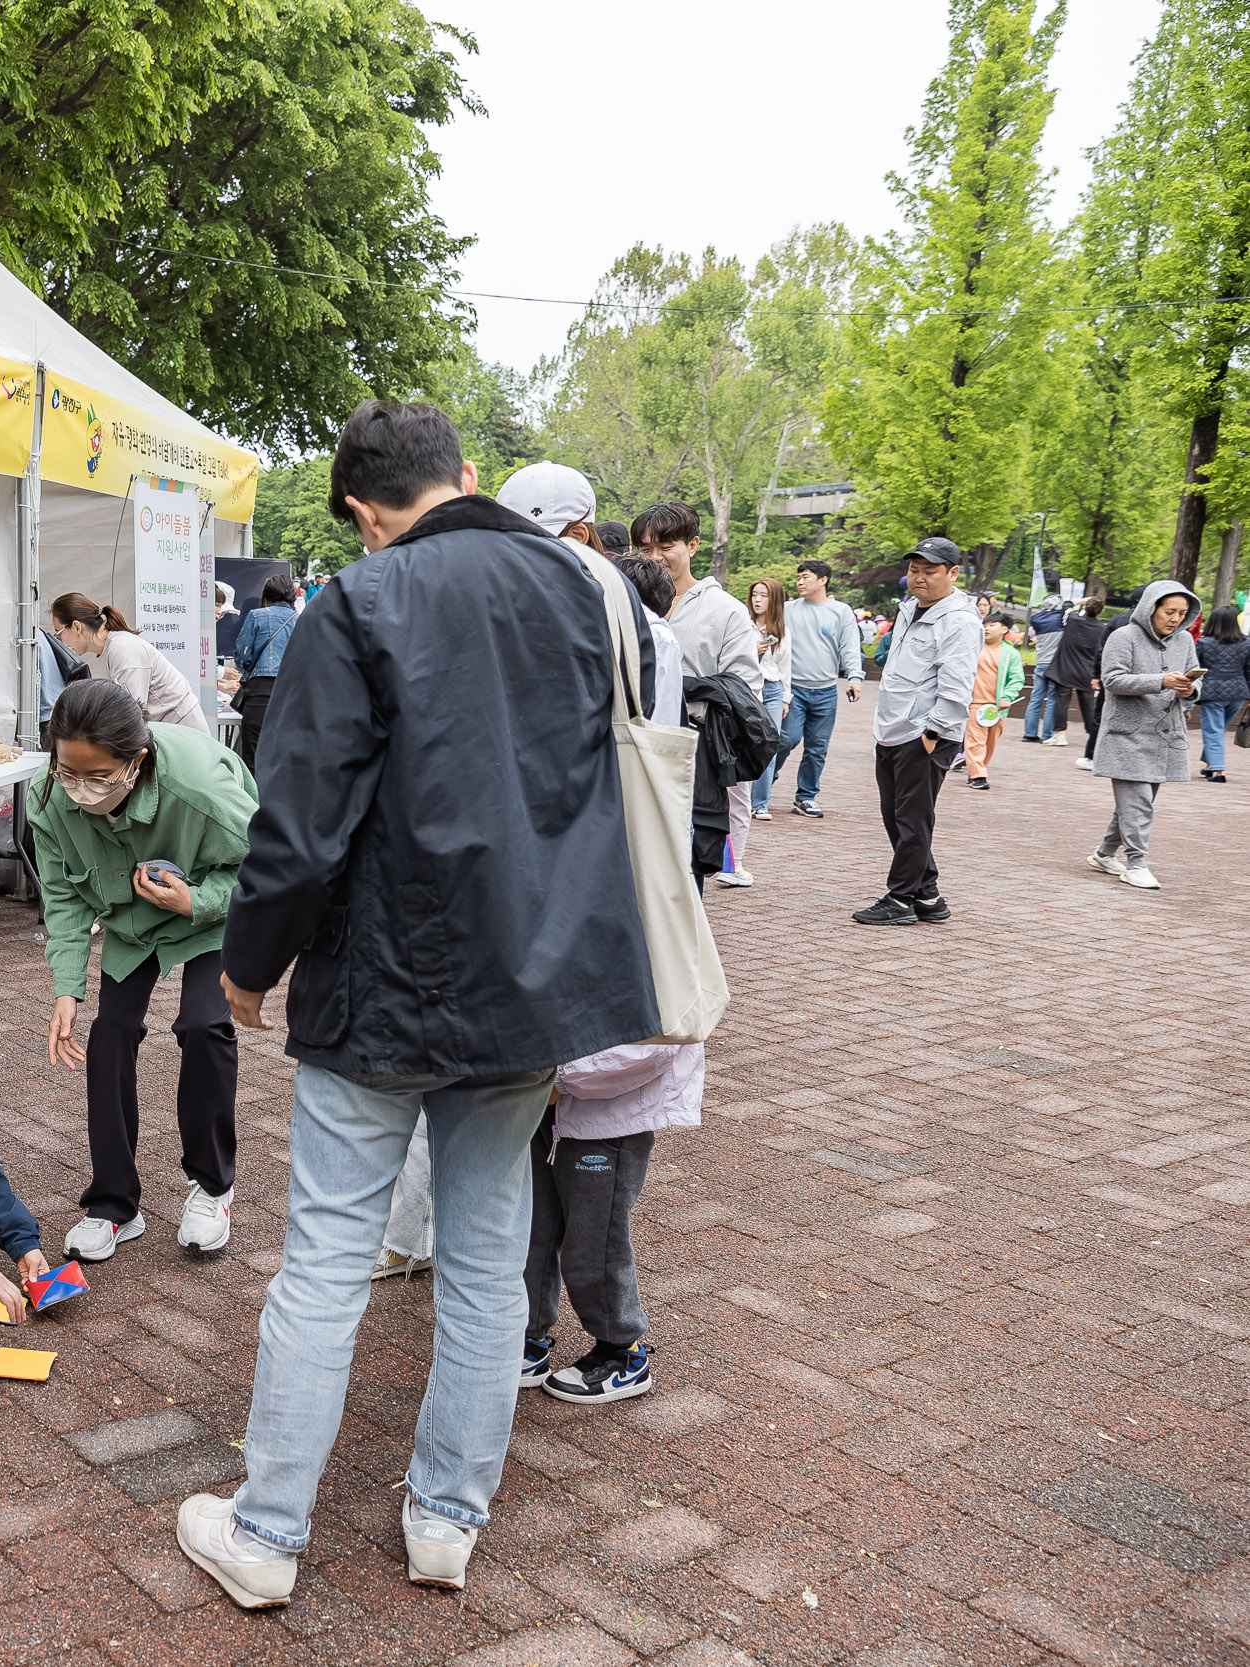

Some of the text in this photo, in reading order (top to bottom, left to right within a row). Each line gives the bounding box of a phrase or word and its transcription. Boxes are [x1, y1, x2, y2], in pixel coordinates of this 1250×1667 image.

[61, 395, 82, 414] 광진구
[155, 511, 192, 537] 아이돌봄
[156, 539, 191, 562] 지원사업
[575, 1161, 612, 1171] Benetton
